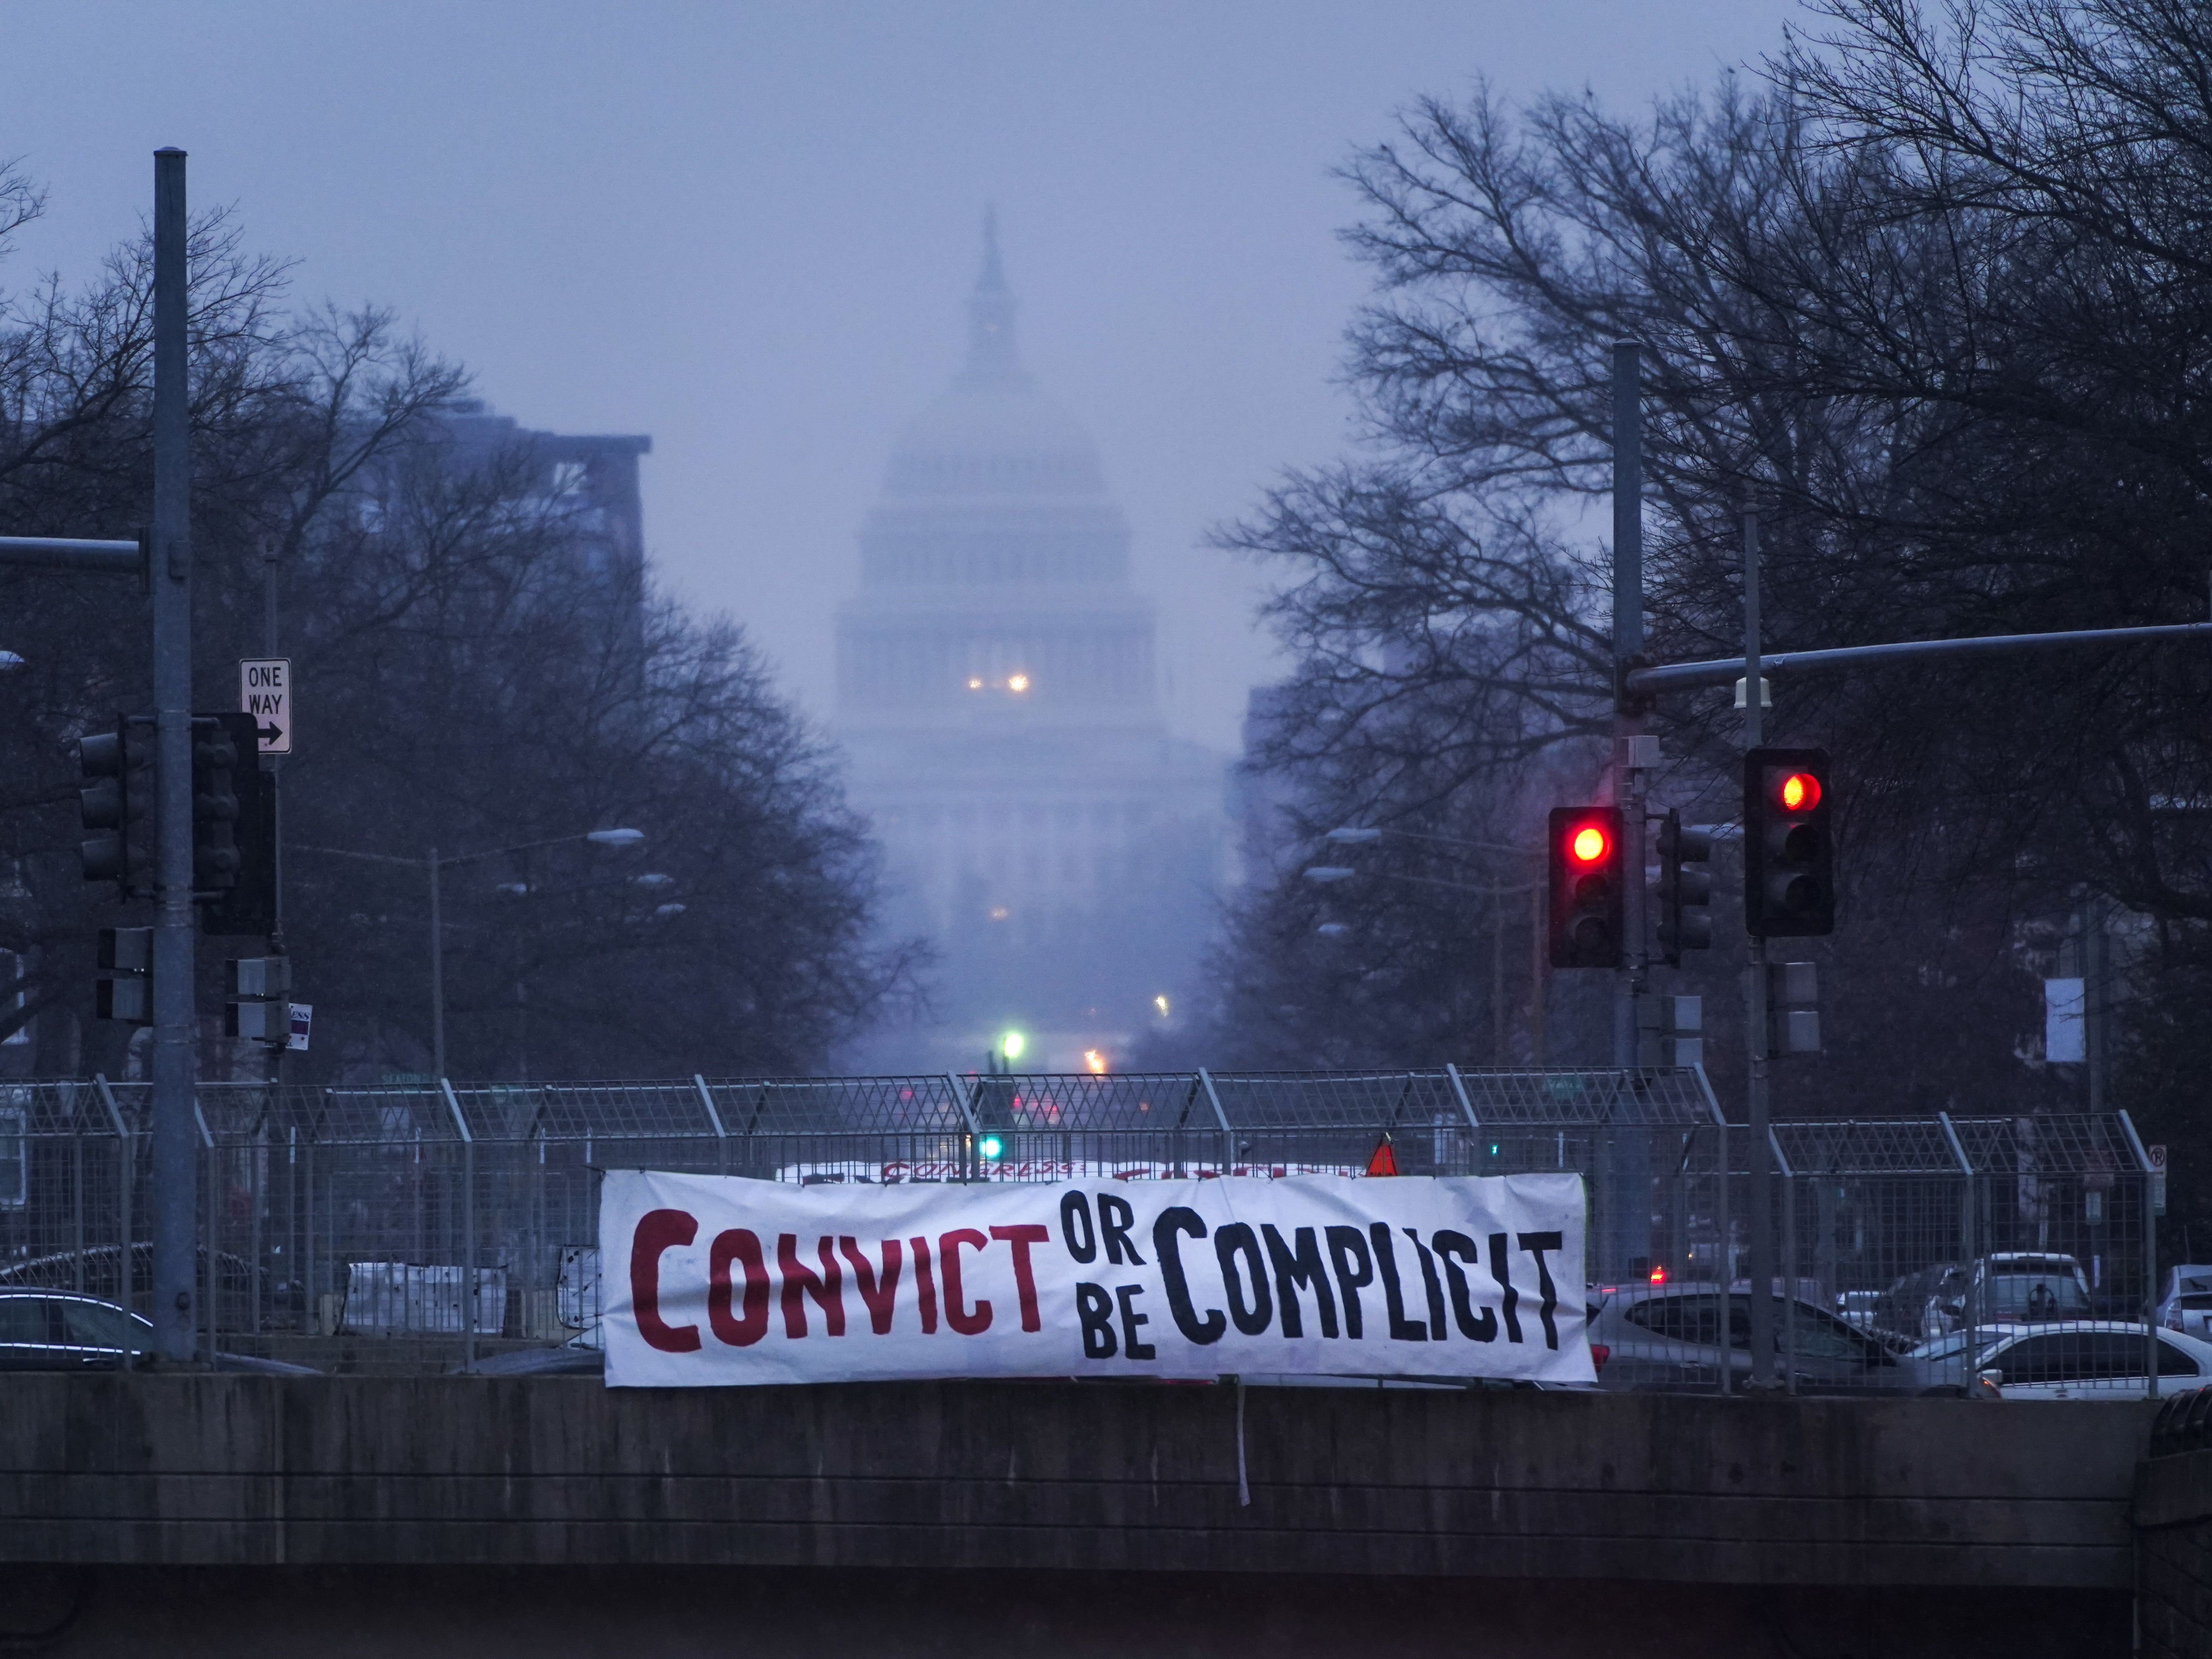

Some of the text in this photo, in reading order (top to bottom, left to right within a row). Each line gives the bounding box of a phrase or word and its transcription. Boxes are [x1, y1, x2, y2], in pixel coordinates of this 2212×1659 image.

[249, 667, 282, 687] ONE
[249, 694, 282, 714] WAY
[1060, 1190, 1147, 1265] OR
[631, 1209, 1049, 1353] CONVICT
[1152, 1206, 1562, 1351] COMPLICIT
[1076, 1282, 1156, 1360] BE
